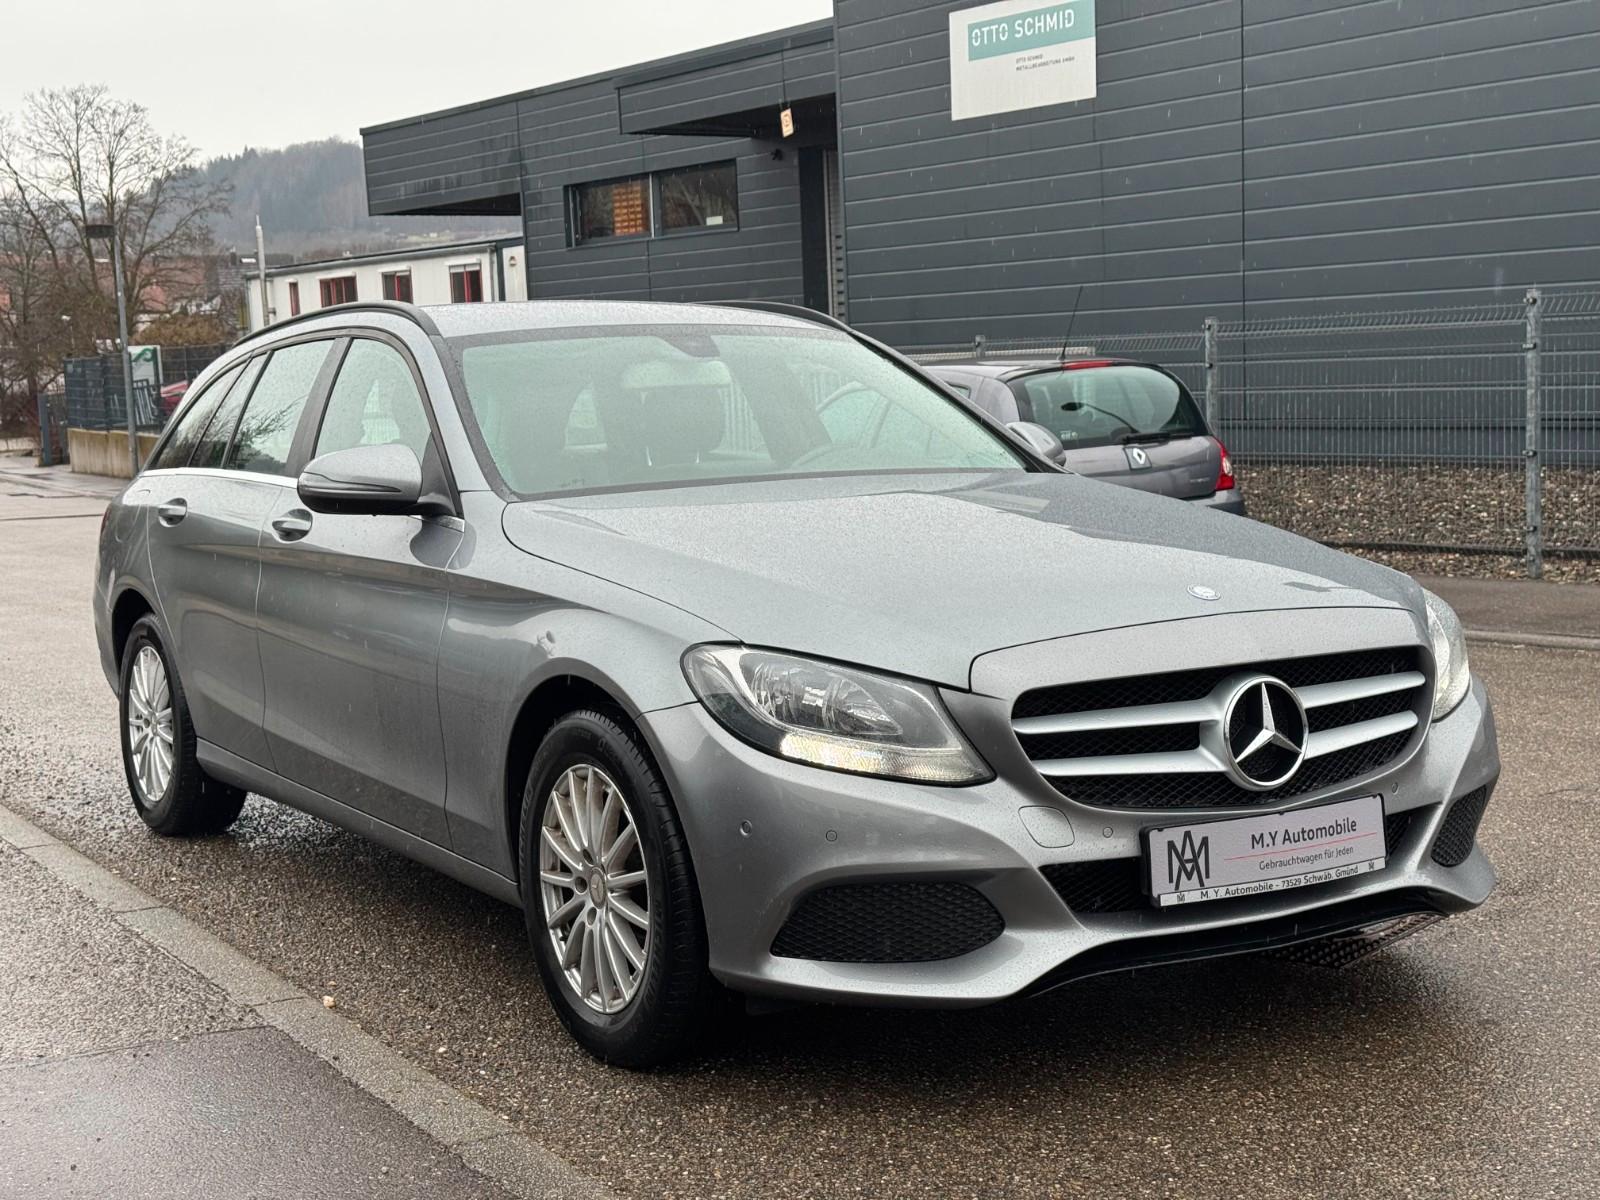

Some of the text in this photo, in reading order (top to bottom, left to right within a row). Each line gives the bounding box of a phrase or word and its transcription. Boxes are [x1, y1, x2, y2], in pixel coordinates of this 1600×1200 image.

[972, 9, 1075, 46] OTTO SCHMID
[1251, 817, 1357, 849] M.Y Automobile
[1259, 853, 1323, 870] Gebrauchtwagen
[1324, 849, 1334, 859] für
[1225, 882, 1274, 896] Automobile
[1281, 878, 1302, 888] 73529
[1335, 865, 1359, 878] Gmünd
